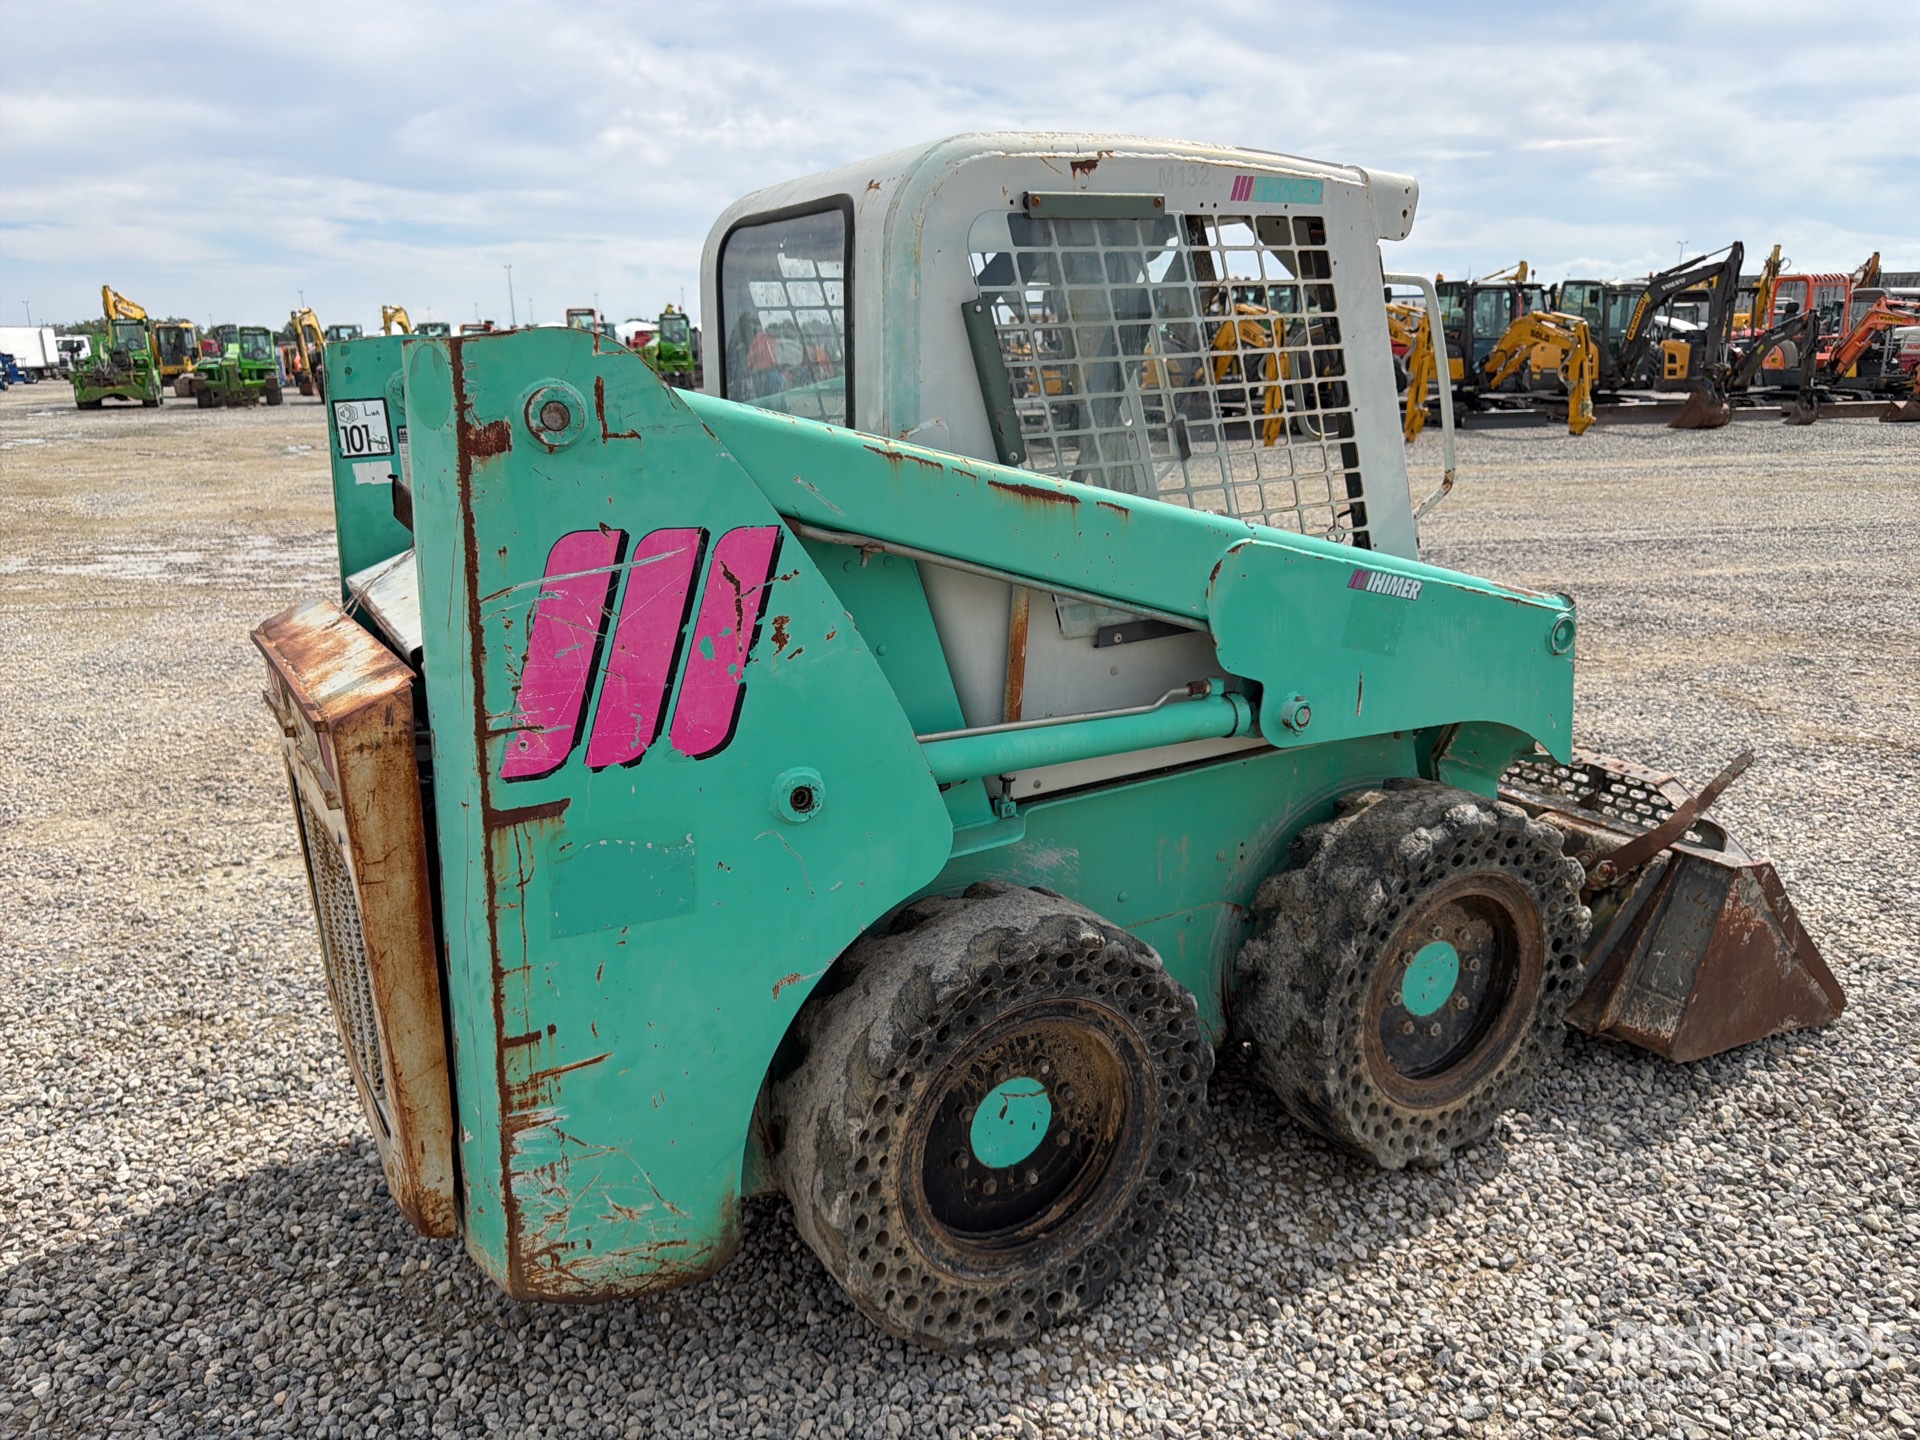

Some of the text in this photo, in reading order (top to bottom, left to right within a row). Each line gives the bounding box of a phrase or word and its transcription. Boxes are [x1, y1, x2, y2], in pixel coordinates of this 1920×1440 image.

[1158, 164, 1210, 187] M132
[1253, 176, 1324, 204] IHIMER
[1661, 277, 1687, 291] VOLVO
[1530, 329, 1550, 343] SDLG
[340, 424, 372, 454] 101
[1365, 571, 1423, 600] IHIMER
